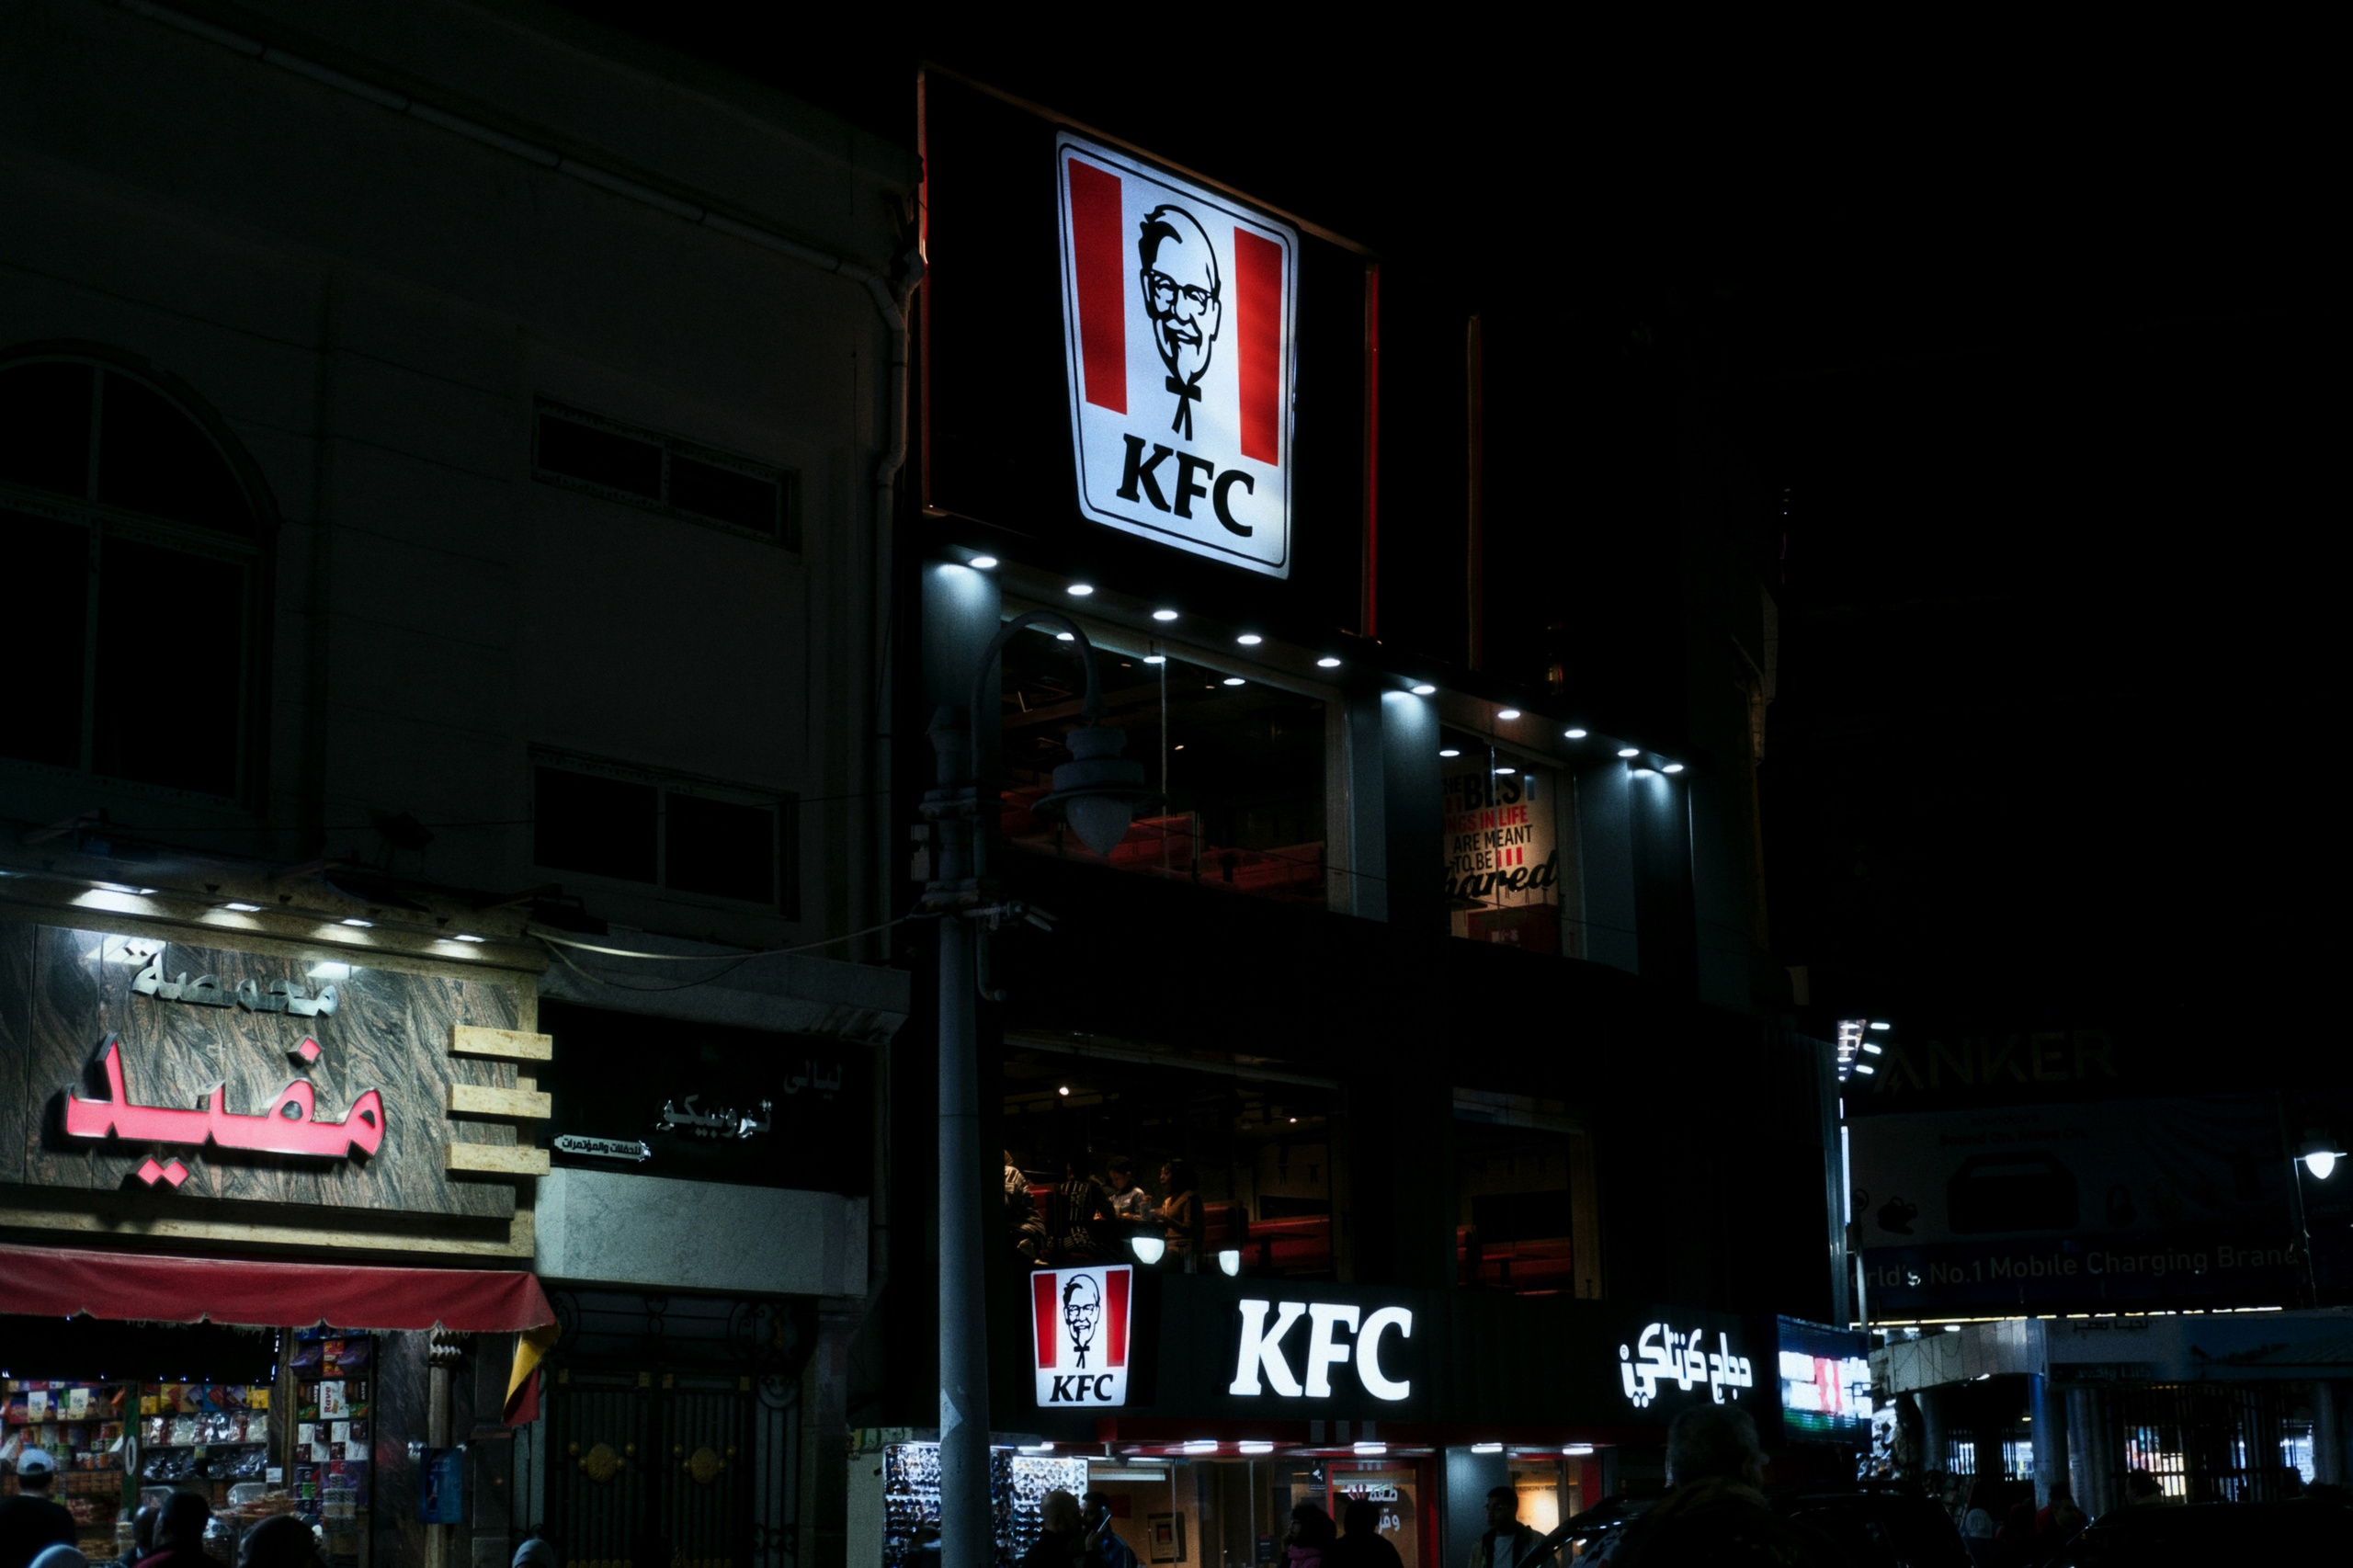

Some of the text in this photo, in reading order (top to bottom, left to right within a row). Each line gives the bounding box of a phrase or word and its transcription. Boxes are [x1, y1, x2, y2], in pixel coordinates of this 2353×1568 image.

[1116, 433, 1255, 538] KFC
[1443, 775, 1461, 796] HE
[1443, 805, 1528, 835] INGS IN LIFE
[1454, 824, 1532, 853] ARE MEANT
[1443, 847, 1557, 899] hared
[1454, 851, 1493, 874] TO BE
[123, 929, 338, 1017] محمصة
[1872, 1028, 2119, 1096] ANKER
[63, 1031, 386, 1189] مفيد
[562, 1137, 642, 1156] للحفلات والمؤتمرات
[1939, 1130, 1986, 1146] Sound
[2018, 1128, 2061, 1142] Move
[1929, 1260, 1983, 1285] No.1
[1990, 1253, 2078, 1279] Mobile
[2086, 1246, 2208, 1277] Charging
[1229, 1299, 1414, 1402] KFC
[1620, 1323, 1708, 1408] كنتاكي
[1709, 1332, 1753, 1405] دجاج
[1050, 1373, 1114, 1403] KFC
